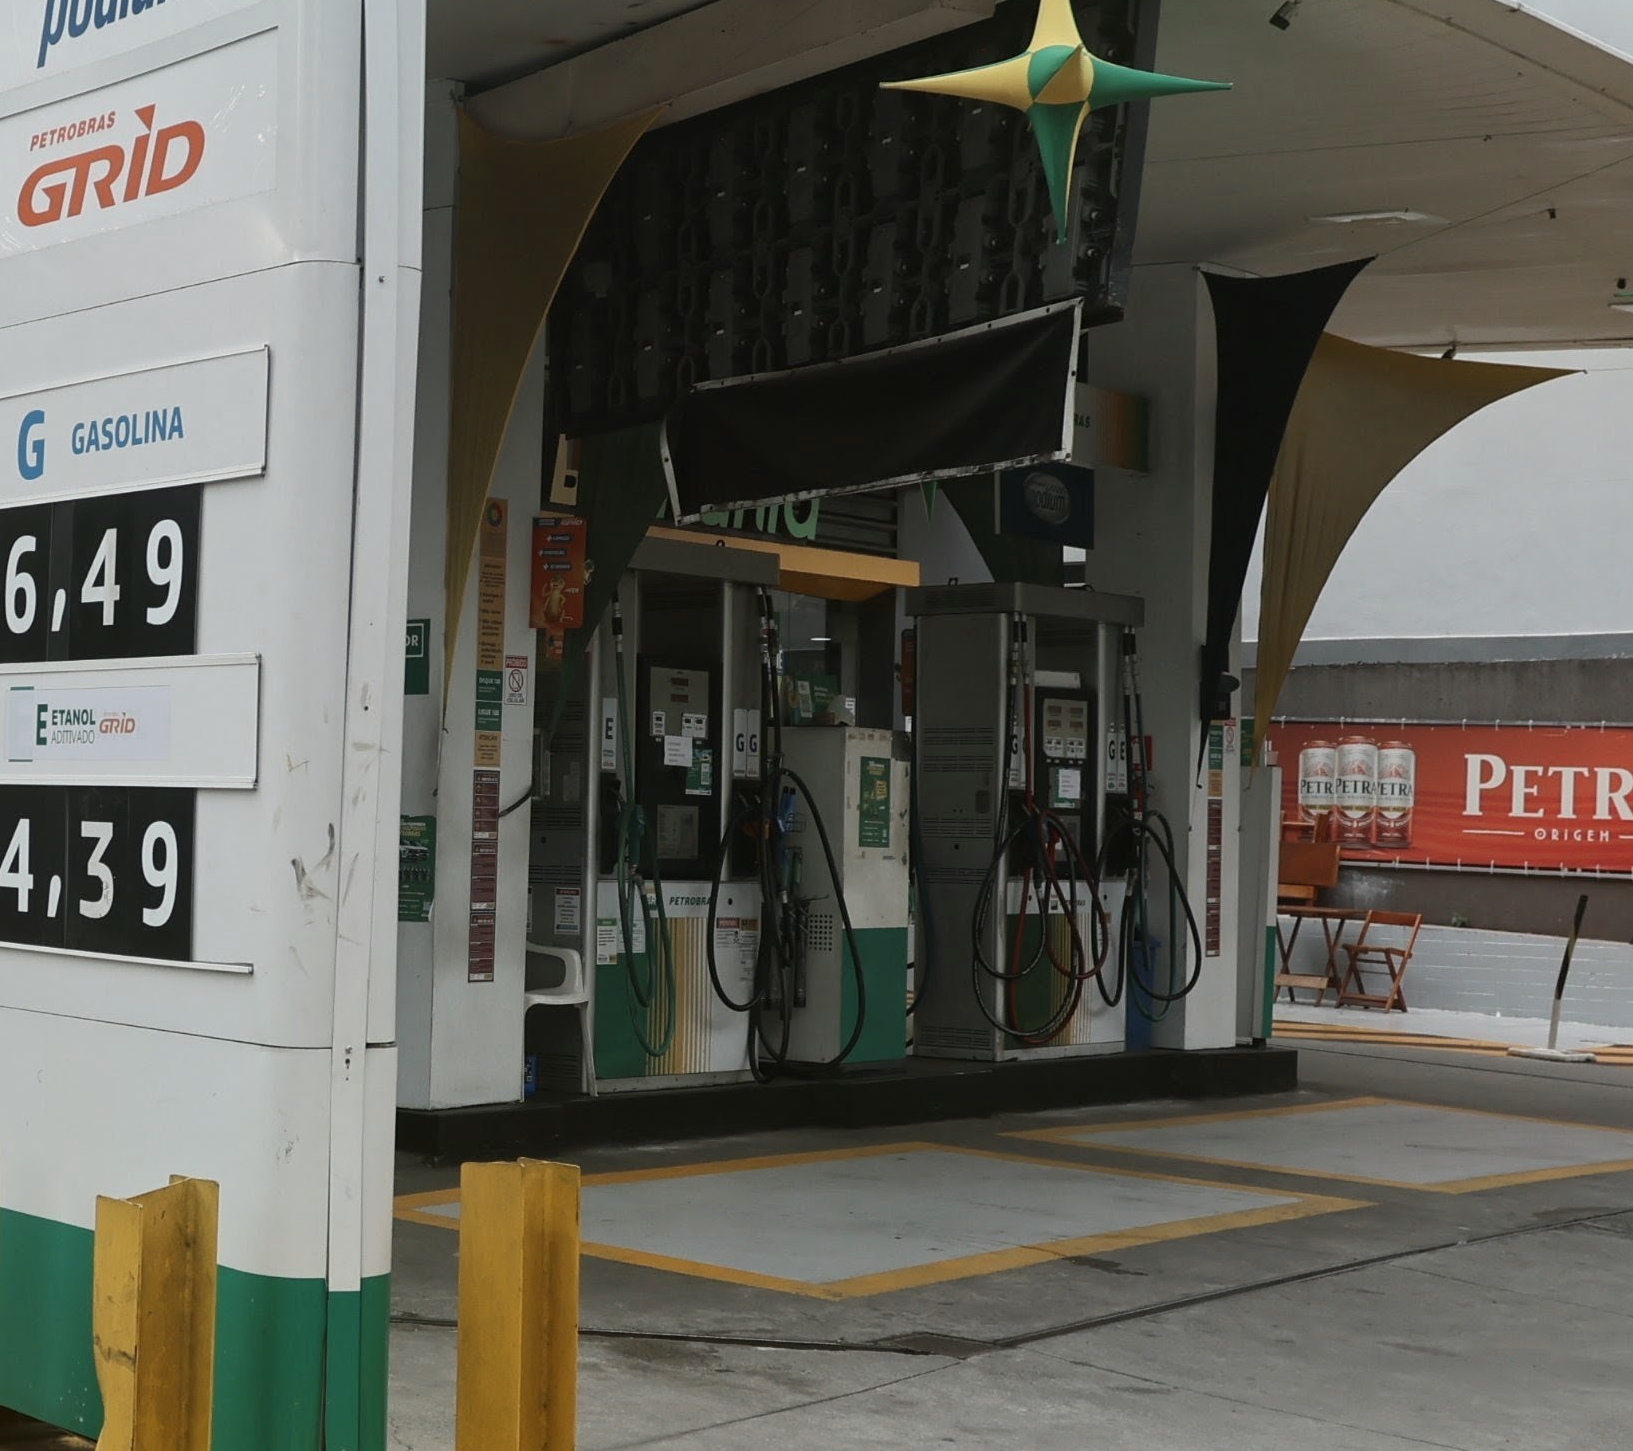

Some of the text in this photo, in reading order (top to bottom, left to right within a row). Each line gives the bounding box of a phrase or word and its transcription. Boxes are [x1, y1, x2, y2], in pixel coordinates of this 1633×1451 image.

[30, 111, 115, 151] PETROBRAS
[18, 104, 205, 227] GRID
[17, 406, 184, 480] G GASOLINA
[4, 519, 184, 634] 6,49
[36, 704, 48, 745] E
[52, 709, 95, 726] ETANOL
[51, 730, 95, 745] ADITIVADO
[606, 718, 613, 739] E
[736, 733, 757, 752] G G
[1534, 828, 1610, 842] ORIGEM
